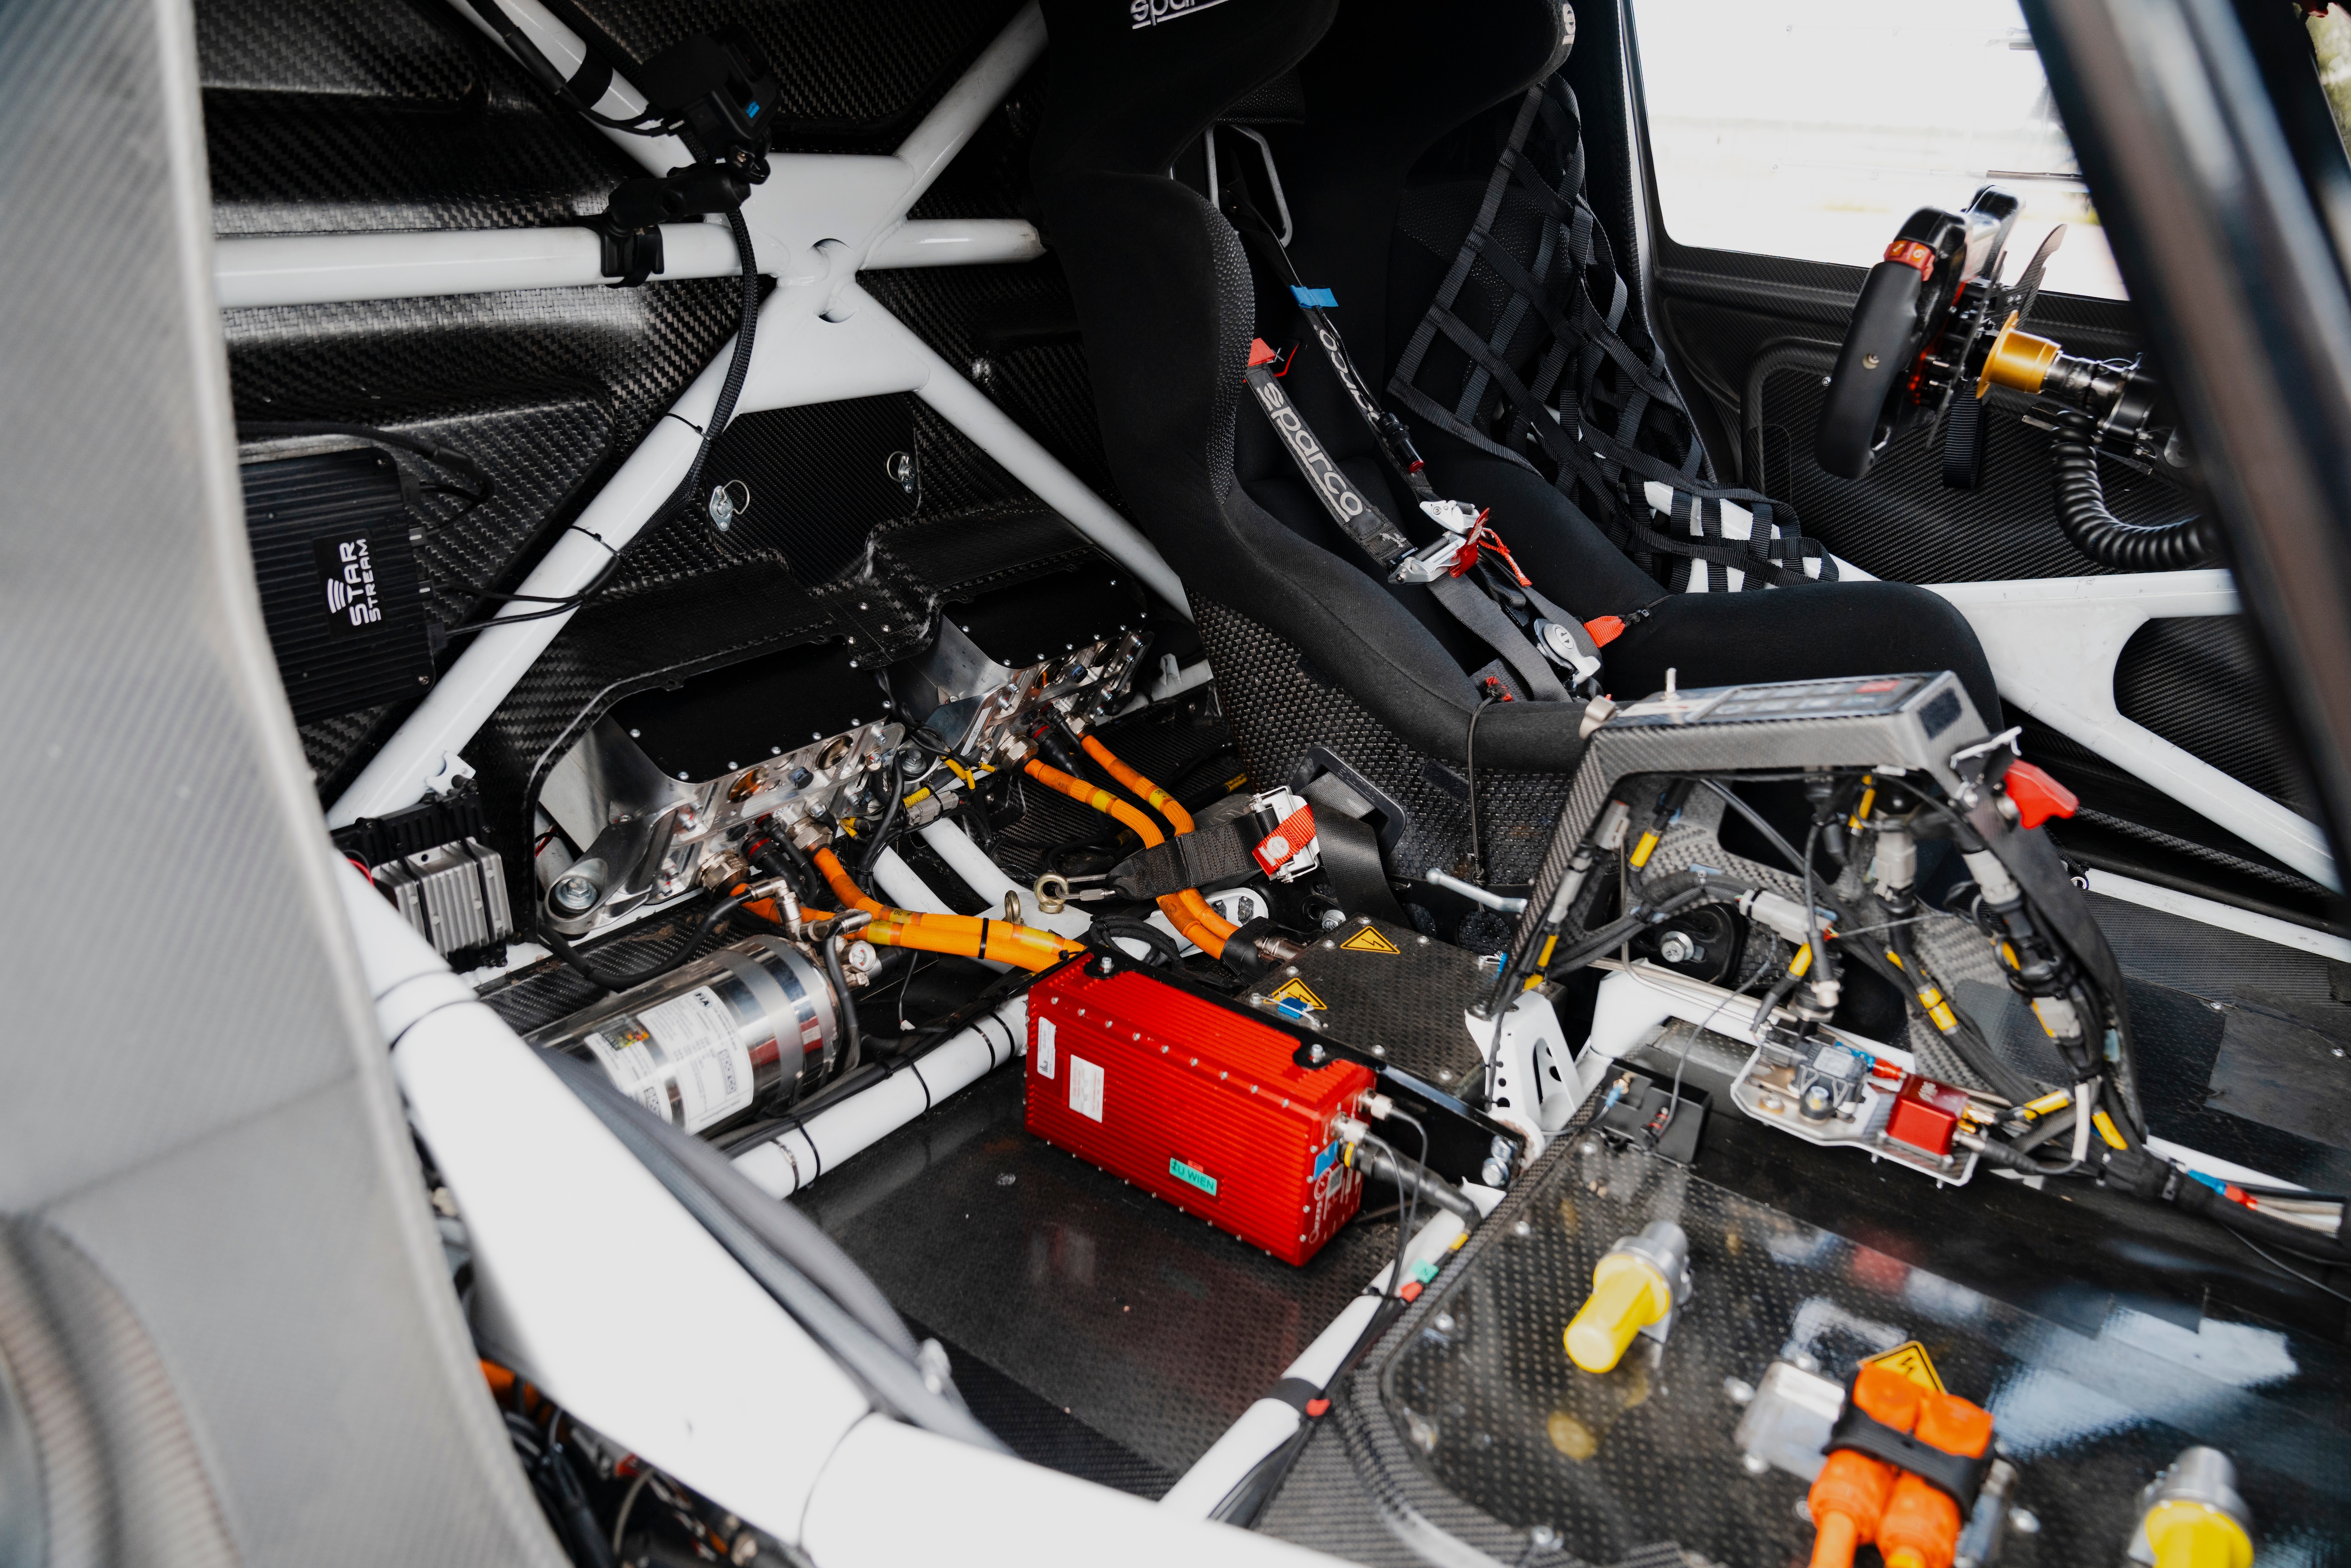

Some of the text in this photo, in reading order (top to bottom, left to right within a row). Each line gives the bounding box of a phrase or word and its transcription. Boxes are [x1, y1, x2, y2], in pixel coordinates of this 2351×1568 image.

[1262, 383, 1363, 518] sparco
[339, 542, 369, 626] STAR
[356, 538, 381, 622] STREAM
[695, 992, 710, 1007] FIA
[1188, 1169, 1214, 1191] WIEN
